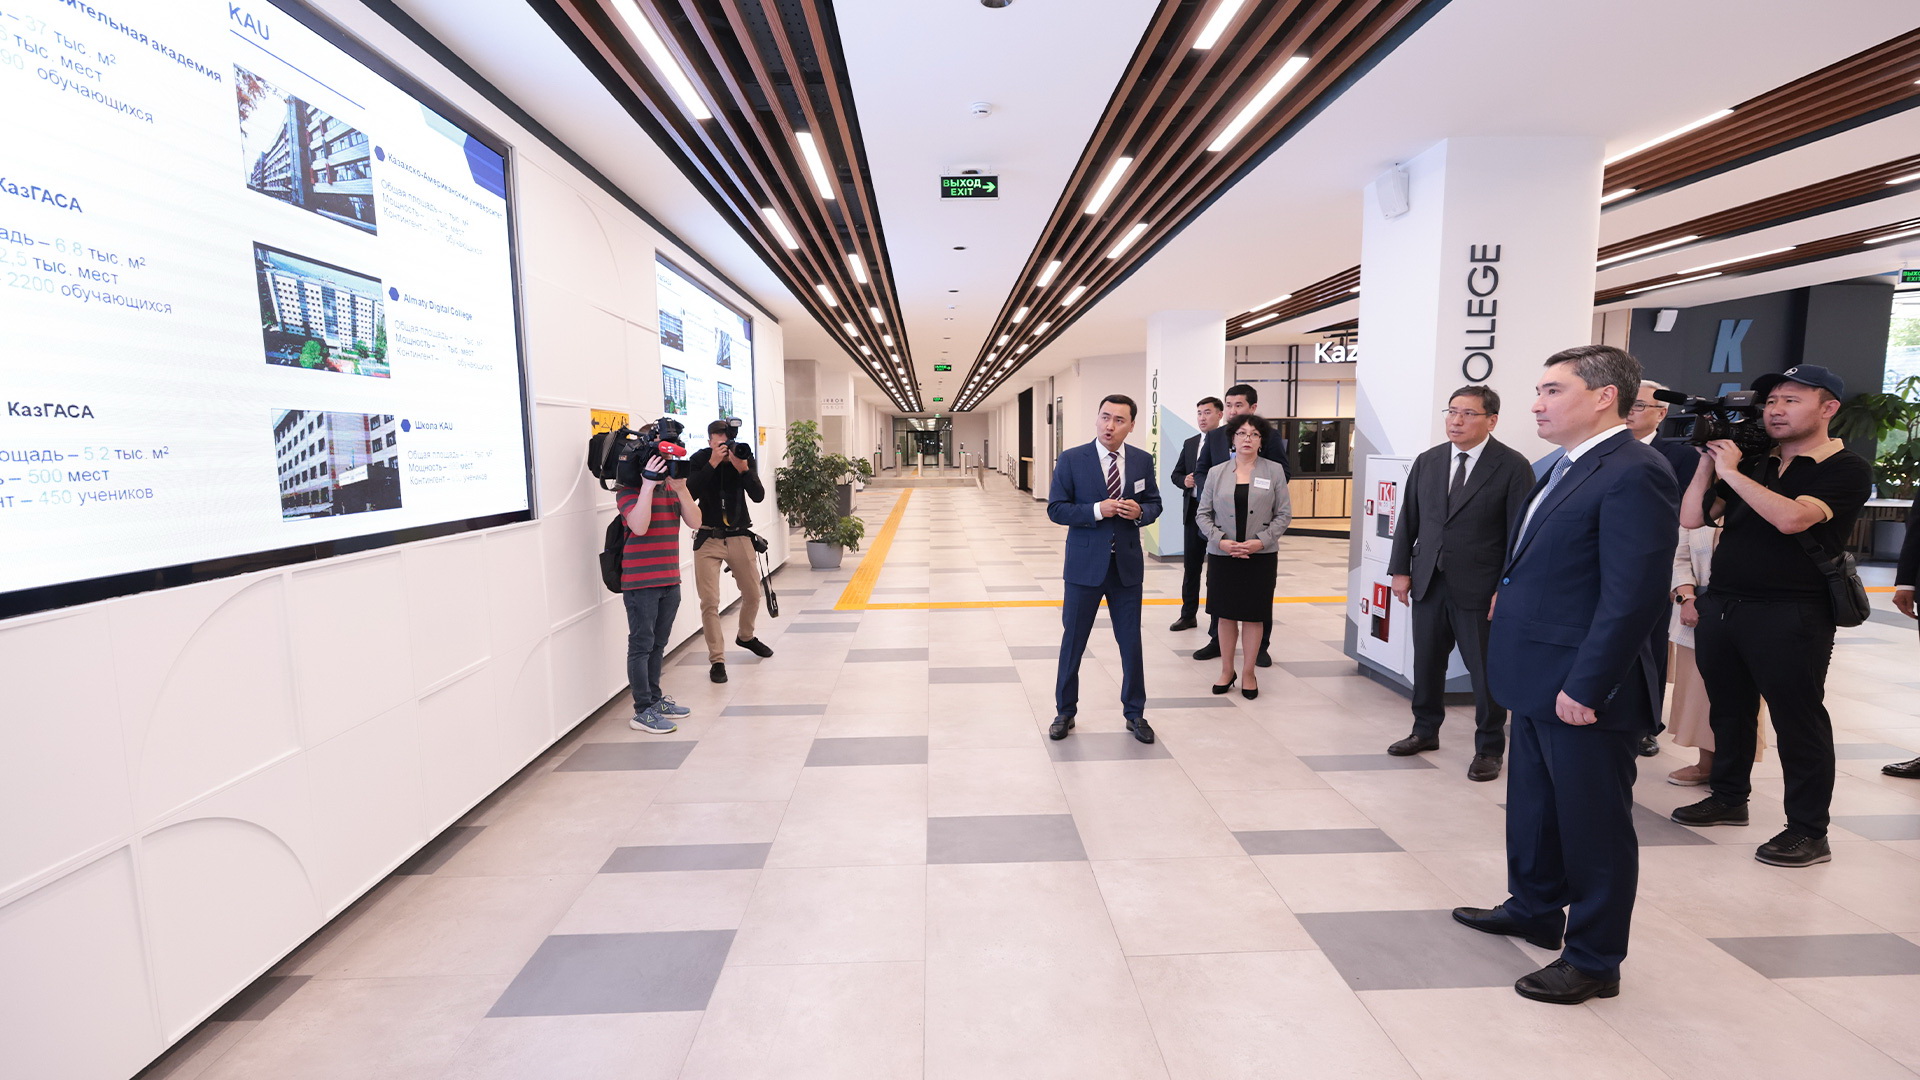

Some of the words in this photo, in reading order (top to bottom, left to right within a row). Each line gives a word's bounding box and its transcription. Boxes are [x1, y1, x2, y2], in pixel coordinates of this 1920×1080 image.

[228, 1, 270, 40] KAU
[25, 15, 46, 35] 37
[54, 30, 91, 58] тыс.
[58, 0, 149, 46] ительная
[151, 39, 223, 83] академия
[13, 34, 54, 62] тыс.
[60, 55, 103, 83] мест
[37, 67, 154, 124] обучающихся
[943, 179, 981, 188] ВЫХОД
[951, 188, 974, 196] EXIT
[87, 247, 124, 267] тыс.
[32, 257, 73, 277] тыс.
[78, 267, 119, 285] мест
[7, 271, 55, 294] 2200
[61, 283, 172, 315] обучающихся
[403, 293, 428, 310] Almaty
[429, 300, 450, 315] Digital
[450, 307, 473, 321] College
[1462, 244, 1501, 389] OLLEGE
[395, 333, 431, 349] Мощность
[1314, 341, 1358, 364] Kaz
[7, 401, 95, 419] КазГАСА
[414, 420, 438, 430] Школа
[114, 448, 149, 461] тыс.
[28, 468, 63, 484] 500
[68, 469, 110, 482] мест
[38, 489, 72, 506] 450
[77, 487, 154, 507] учеников
